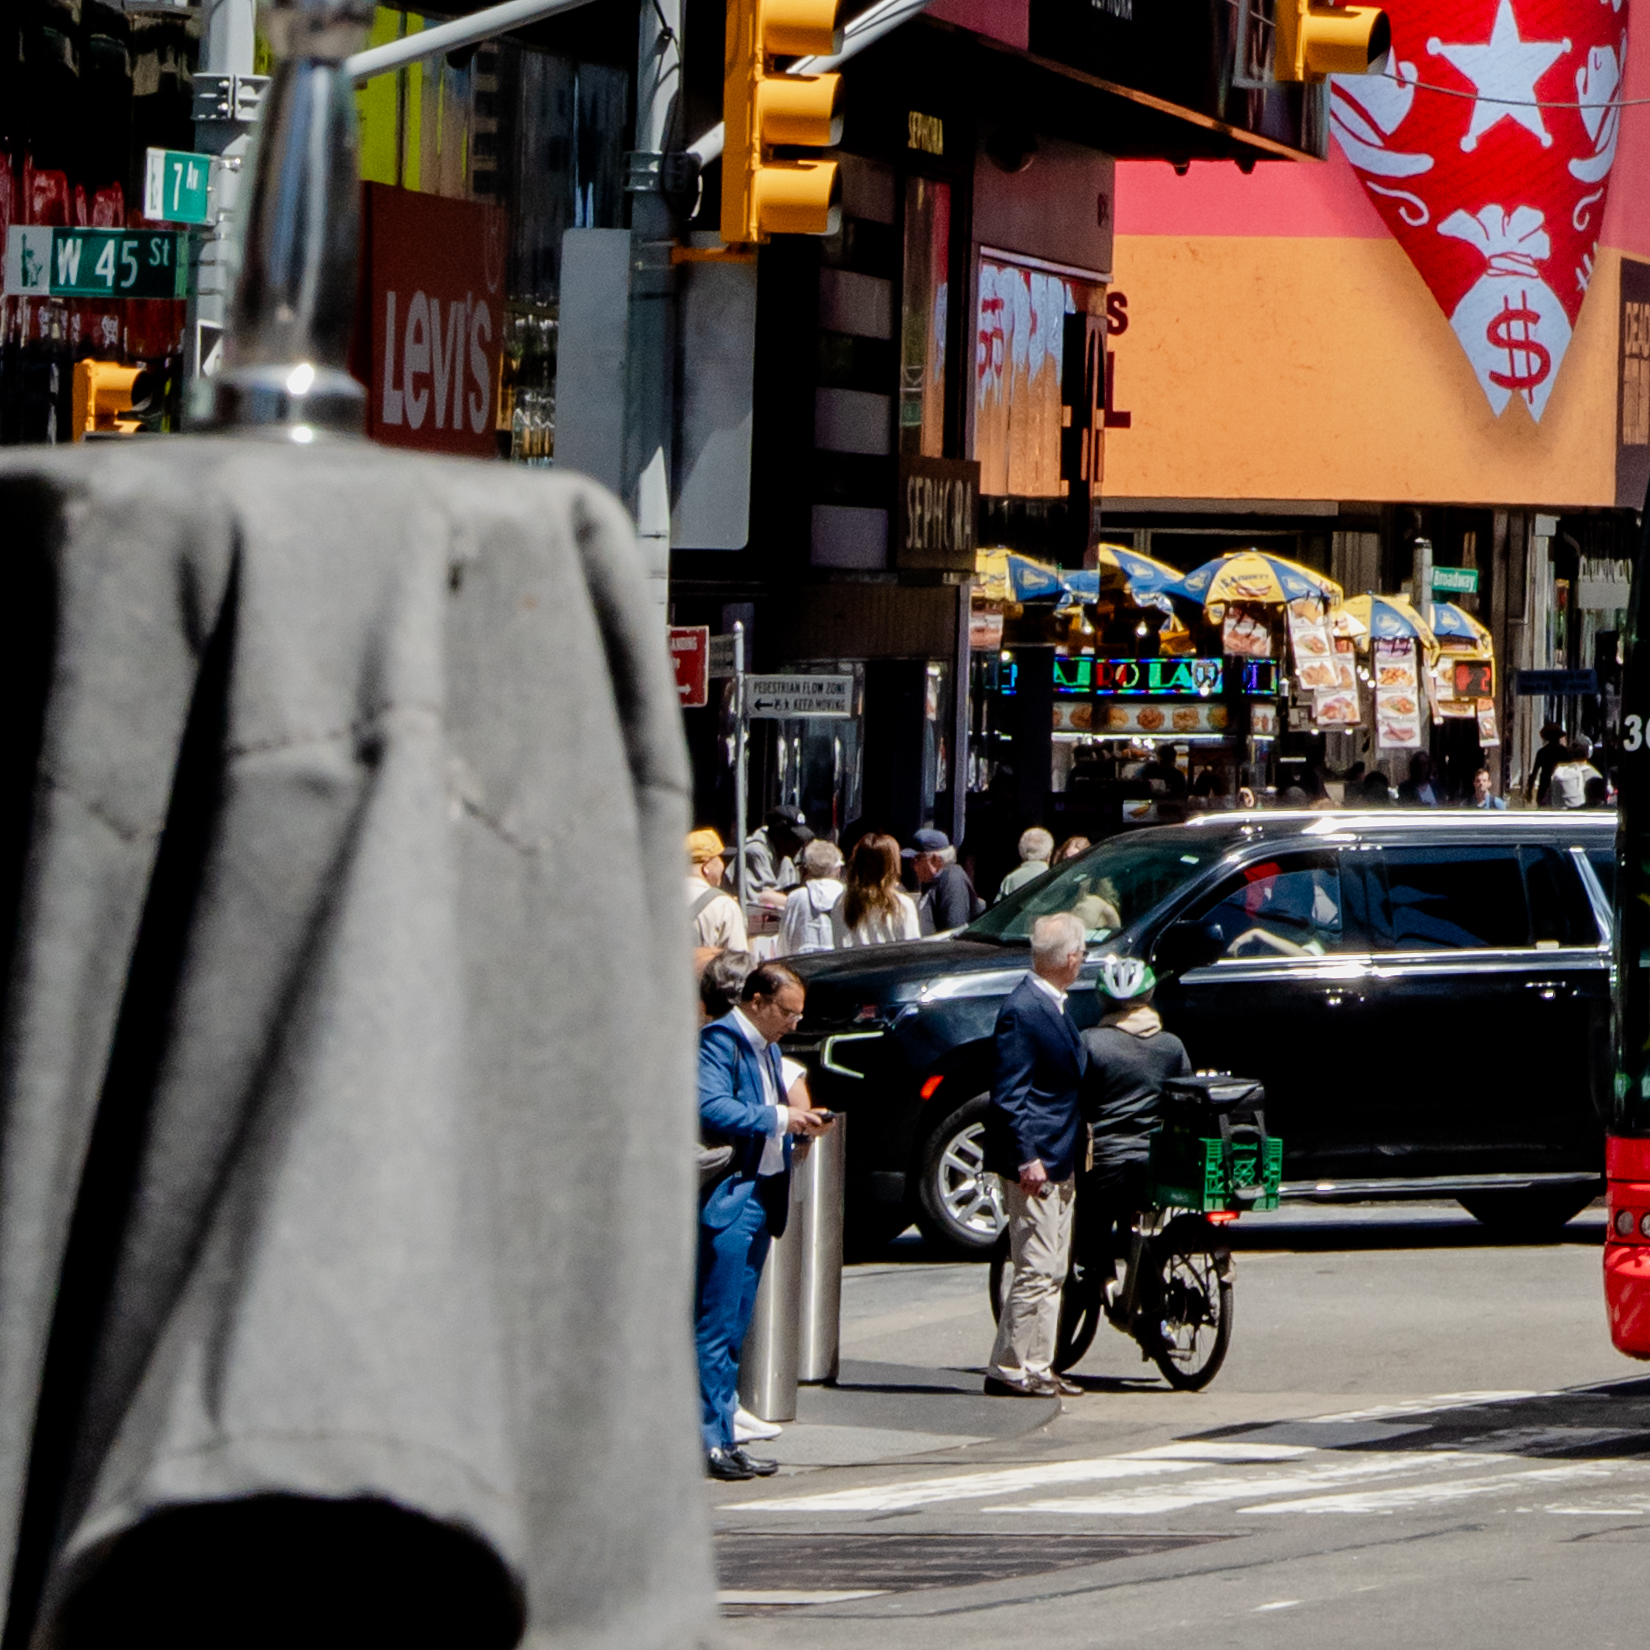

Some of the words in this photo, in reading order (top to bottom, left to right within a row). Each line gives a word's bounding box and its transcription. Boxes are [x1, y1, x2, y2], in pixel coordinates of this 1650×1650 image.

[173, 162, 183, 212] 7
[58, 238, 82, 286] W
[95, 238, 139, 288] 45
[149, 237, 171, 267] St
[1433, 570, 1477, 592] Broadway
